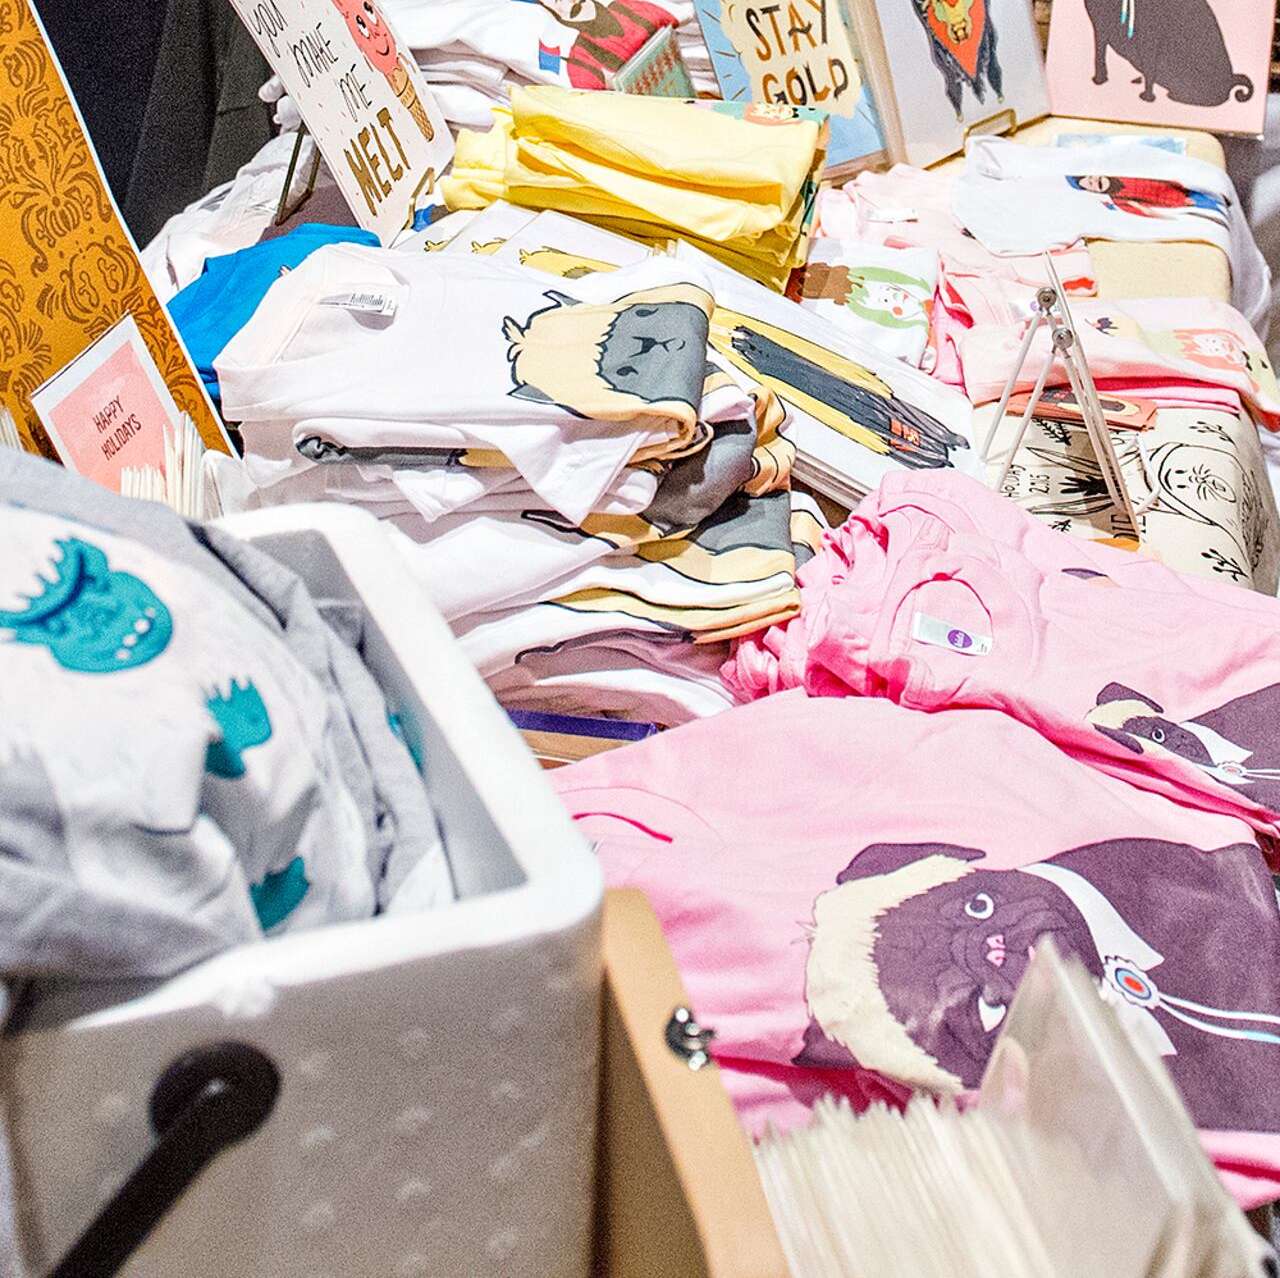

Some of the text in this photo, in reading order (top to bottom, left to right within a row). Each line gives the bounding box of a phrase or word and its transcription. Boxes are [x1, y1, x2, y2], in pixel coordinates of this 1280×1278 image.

[289, 22, 339, 89] MAKE
[762, 57, 848, 106] GOLD
[338, 63, 372, 123] ME
[343, 107, 412, 217] MELT
[92, 394, 125, 434] HAPPY
[100, 413, 142, 461] HOLIDAYS
